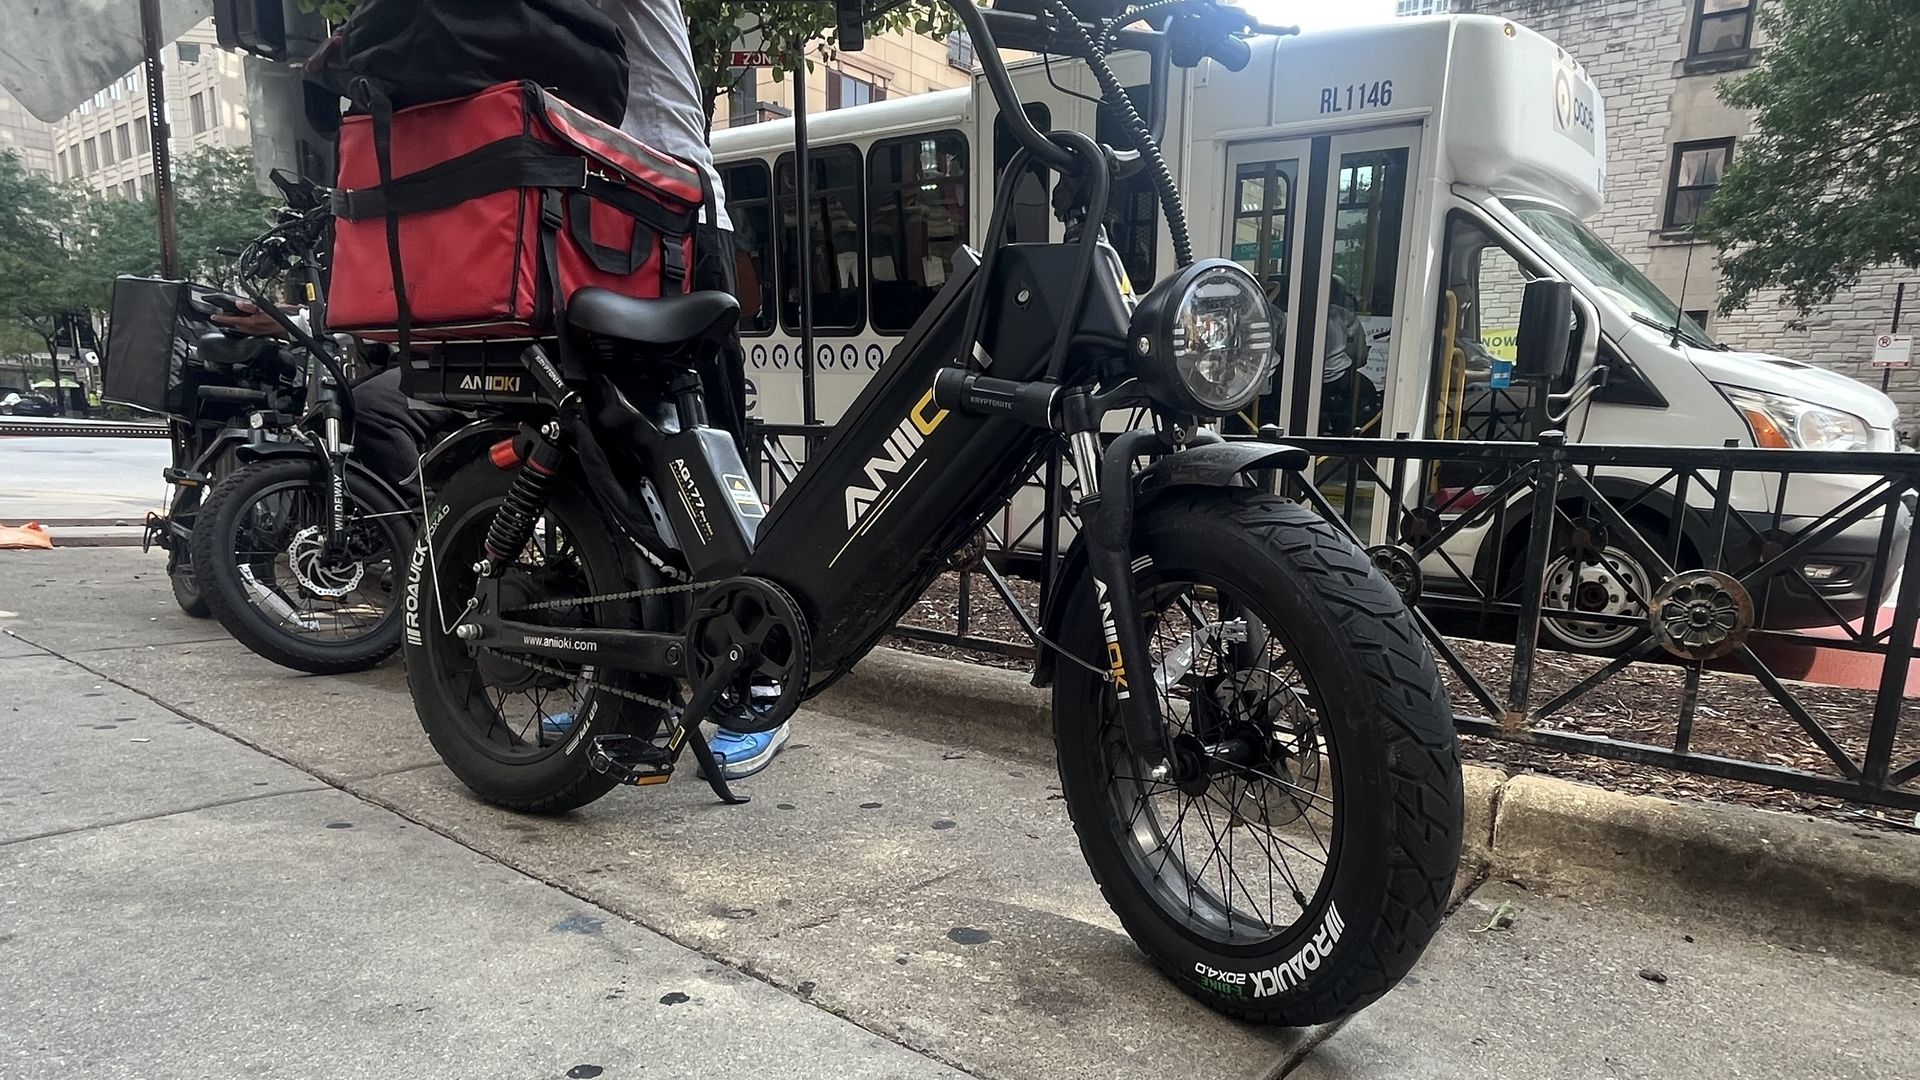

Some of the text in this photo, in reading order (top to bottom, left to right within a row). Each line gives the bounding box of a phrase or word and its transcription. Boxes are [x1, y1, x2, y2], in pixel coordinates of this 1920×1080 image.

[743, 53, 773, 65] ZON
[1320, 79, 1393, 114] RL 1146
[460, 374, 520, 392] ANIIOKI
[970, 396, 1012, 410] KRYPTONITE
[845, 387, 950, 530] ANIIO
[333, 474, 344, 531] WILDEWAY
[674, 458, 705, 508] AQ177
[406, 539, 429, 628] ROAUICK
[523, 635, 598, 652] www.aniioki.com
[1093, 576, 1131, 700] ANIIOKI
[1195, 962, 1247, 985] 20X4.0
[1249, 924, 1333, 998] ROAUICK
